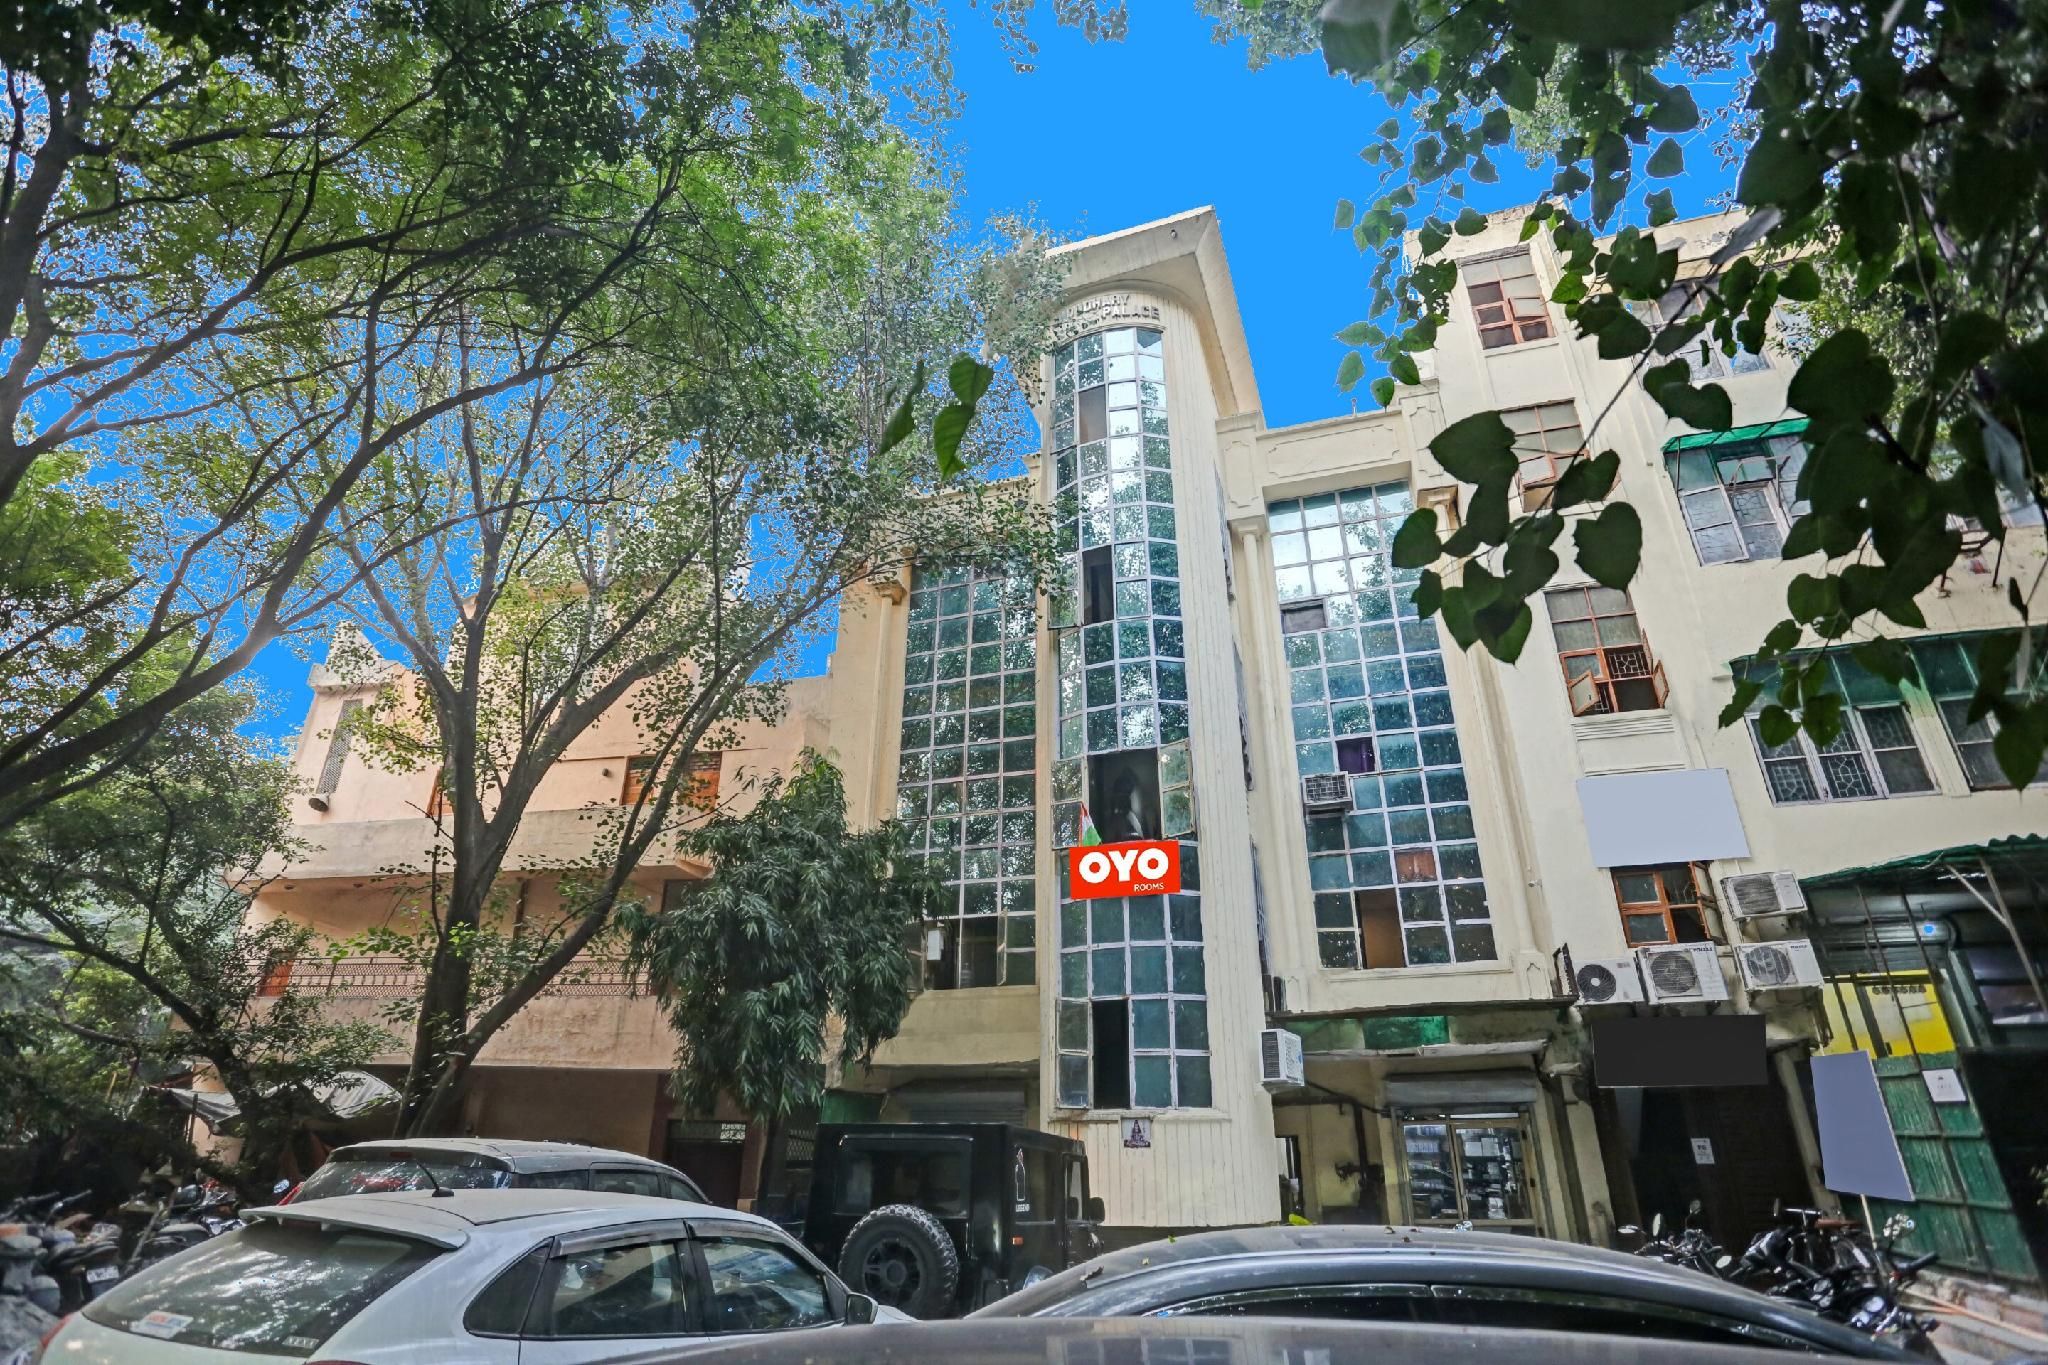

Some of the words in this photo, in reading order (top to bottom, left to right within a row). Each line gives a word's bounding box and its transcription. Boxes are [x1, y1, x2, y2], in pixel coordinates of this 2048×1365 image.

[1101, 303, 1160, 321] PALACE
[1079, 848, 1169, 883] OYO
[1133, 882, 1164, 892] ROOMS
